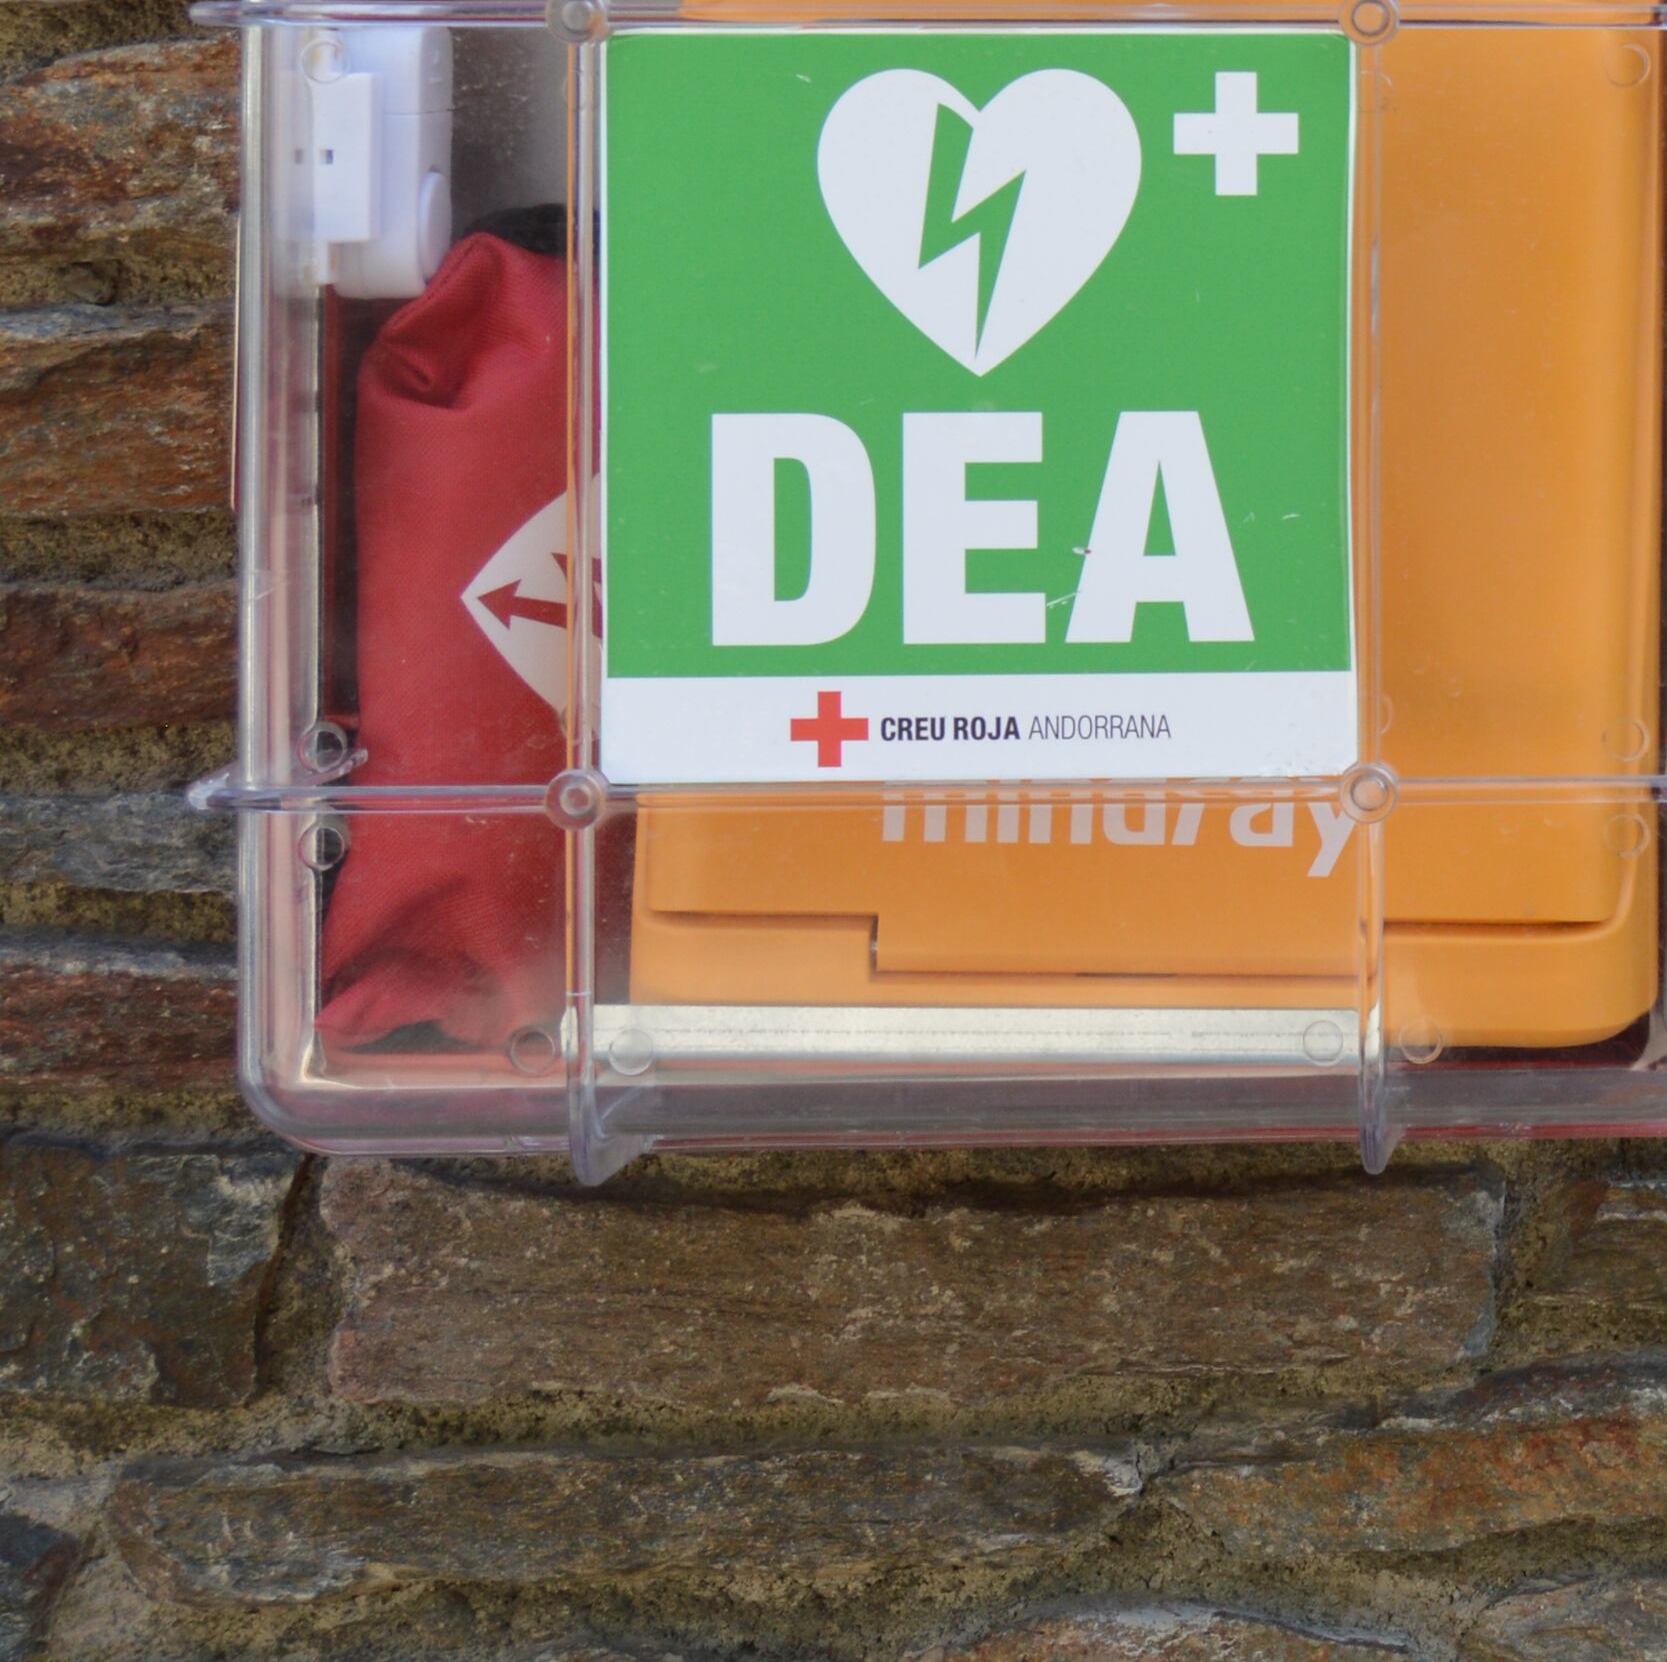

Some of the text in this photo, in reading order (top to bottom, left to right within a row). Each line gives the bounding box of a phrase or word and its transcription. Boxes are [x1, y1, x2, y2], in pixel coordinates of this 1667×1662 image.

[711, 410, 1255, 646] DEA
[880, 713, 1172, 742] CREU ROJA ANDORRANA
